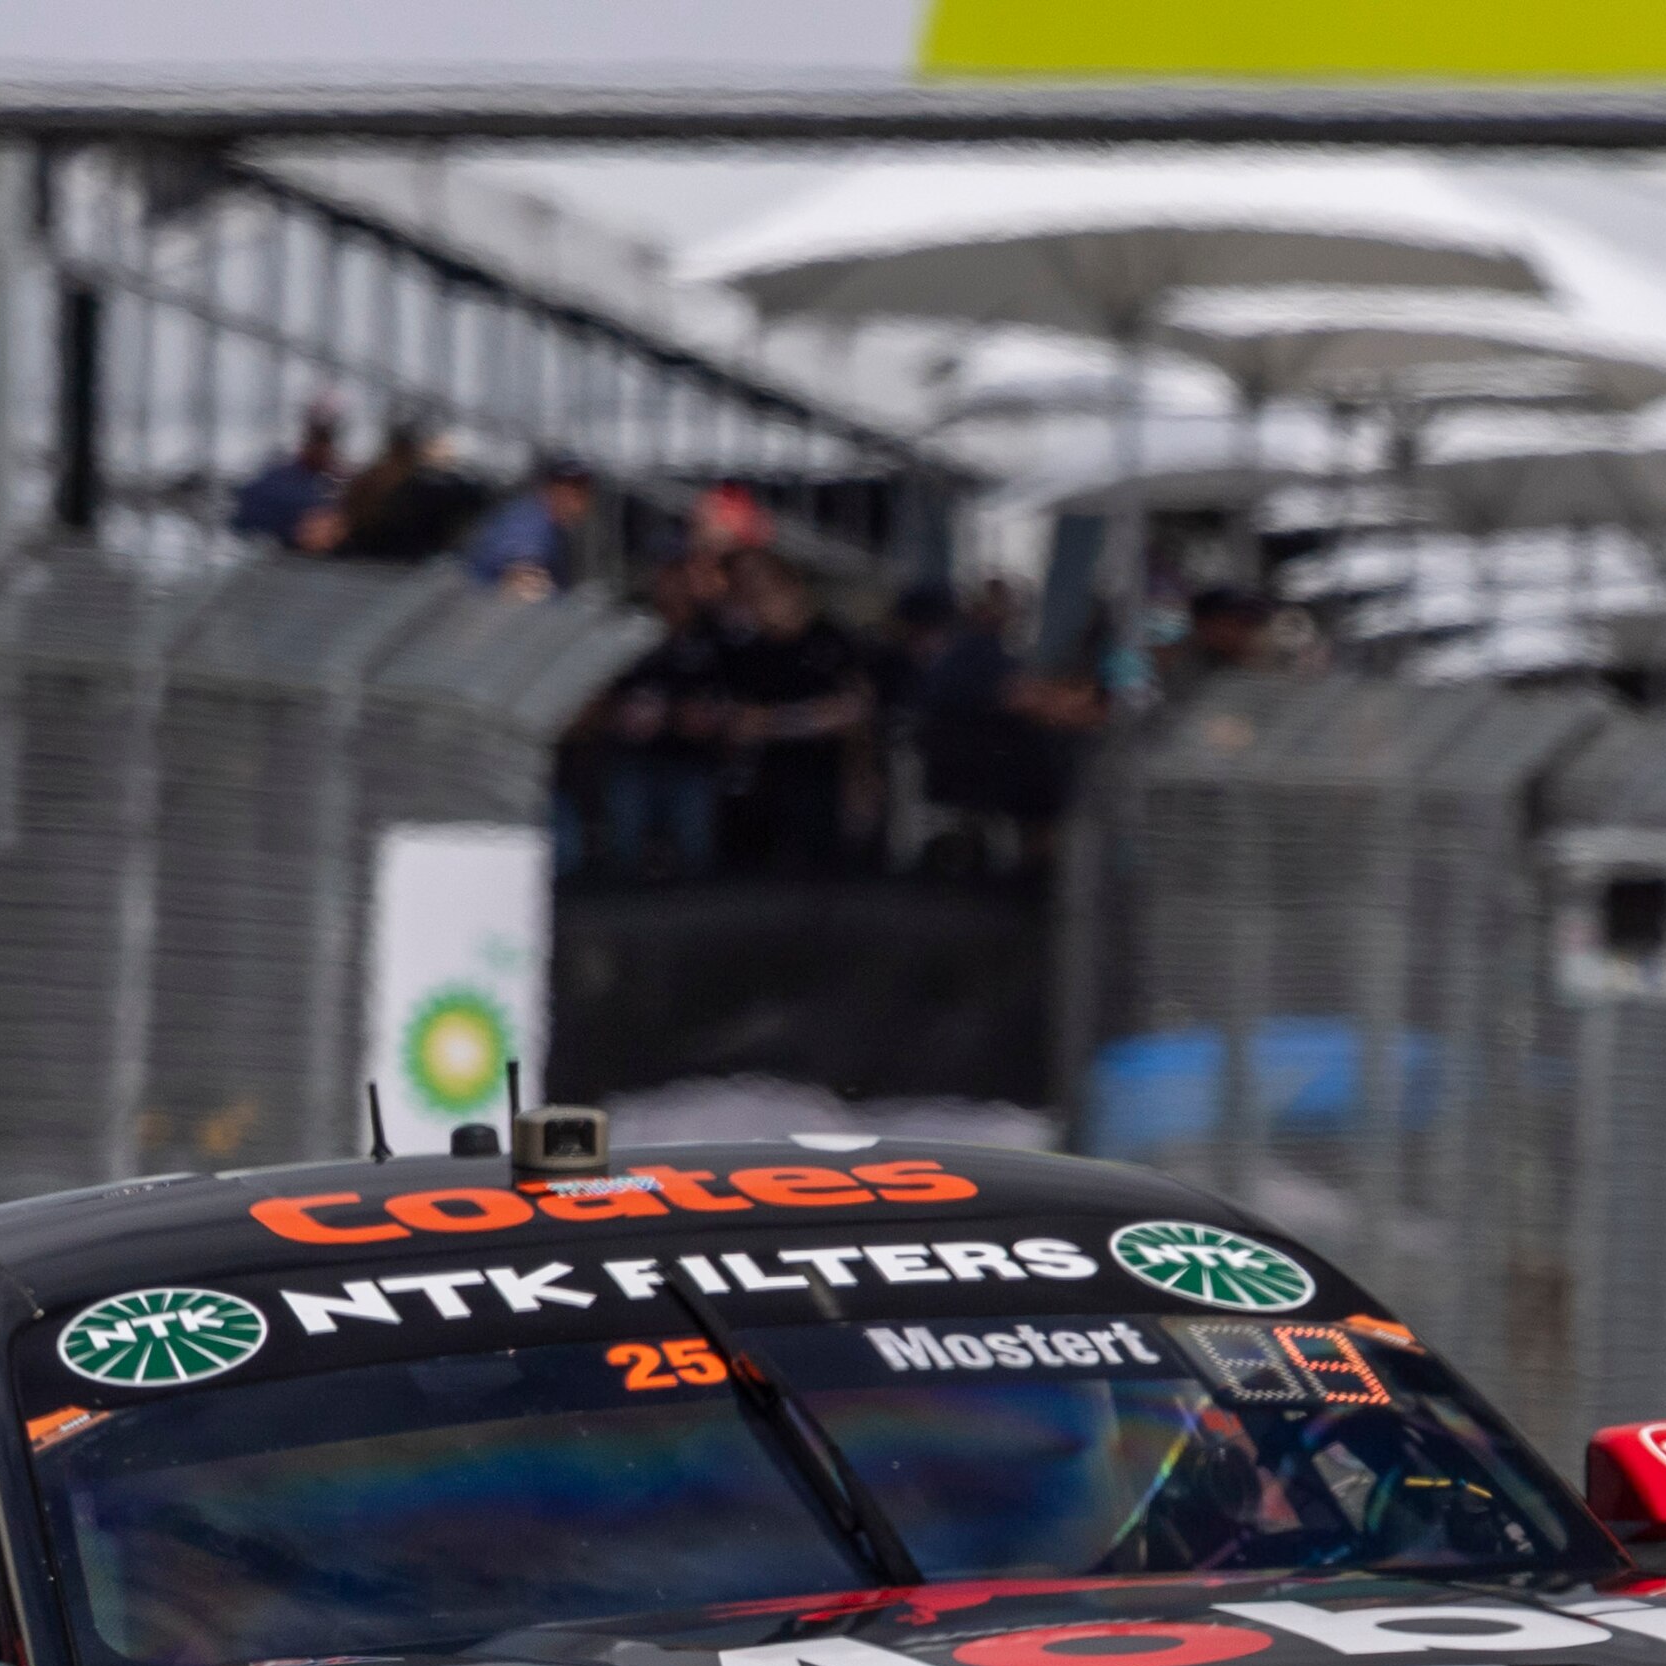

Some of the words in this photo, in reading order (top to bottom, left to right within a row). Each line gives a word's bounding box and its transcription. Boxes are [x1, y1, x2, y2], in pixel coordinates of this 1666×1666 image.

[1136, 1240, 1273, 1272] NTK
[279, 1262, 598, 1335] NTK
[602, 1238, 1099, 1300] FILTERS
[86, 1303, 226, 1350] NTK
[865, 1320, 1161, 1371] Mostert
[606, 1337, 729, 1391] 25
